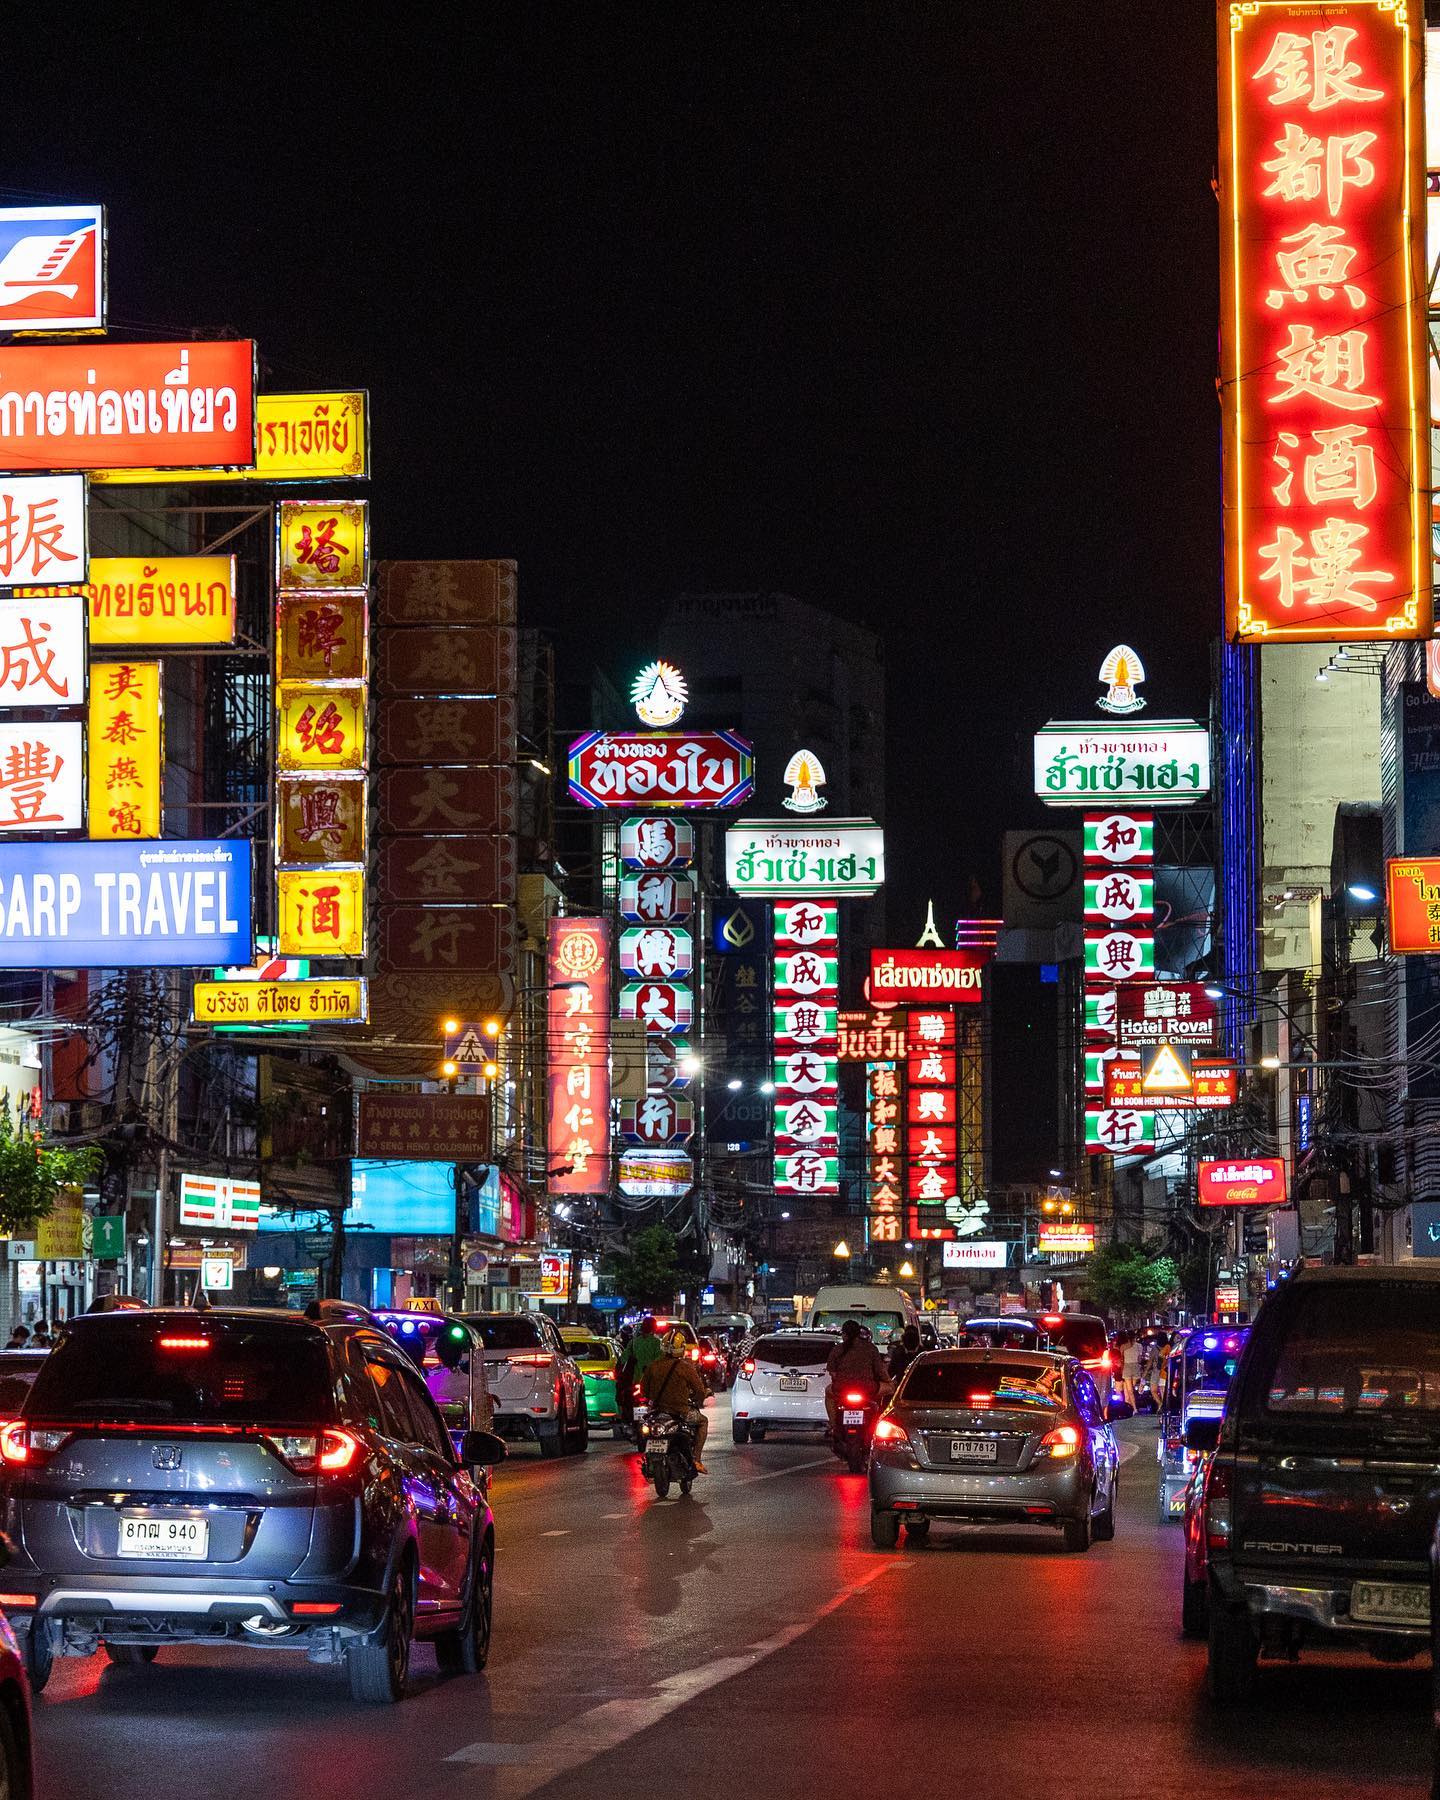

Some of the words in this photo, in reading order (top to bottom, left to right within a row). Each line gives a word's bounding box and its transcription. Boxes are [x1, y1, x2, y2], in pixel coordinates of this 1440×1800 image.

[1252, 25, 1394, 612] 銀都魚翅酒樓
[0, 349, 238, 437] การท่องเที่ยว
[257, 405, 350, 457] ราเจดีย์
[88, 564, 229, 619] ทยรังนก
[594, 737, 667, 759] ห้างทอง
[1078, 738, 1168, 754] ห้างขายทอง
[588, 742, 735, 796] ทองใบ
[1045, 746, 1200, 791] ฮั่วเซ่งเฮง
[766, 834, 841, 850] ห้างขายทอง
[736, 841, 876, 882] ฮั่วเซ่งเฮง
[0, 870, 81, 937] ARP
[95, 870, 239, 935] TRAVEL
[1101, 820, 1137, 1146] 和成興行
[206, 990, 249, 1013] บริษัท
[257, 988, 301, 1013] ดีไทย
[309, 989, 350, 1013] จำกัด
[1121, 1019, 1161, 1033] Hotel
[1121, 1037, 1156, 1046] Bangkok
[1158, 1036, 1167, 1044] @
[1169, 1036, 1212, 1044] Chinatown
[788, 906, 823, 1188] 和成興大金行
[1124, 1097, 1143, 1105] SOON
[1196, 1096, 1231, 1105] MEDICINE
[919, 1015, 948, 1237] 聯成興大金
[433, 1143, 483, 1153] GOLDSMITH
[873, 1070, 899, 1239] 振和興大金行
[407, 1301, 434, 1311] TAXI
[973, 1442, 996, 1452] 7812
[168, 1524, 197, 1539] 940
[1243, 1541, 1343, 1554] FRONTIER
